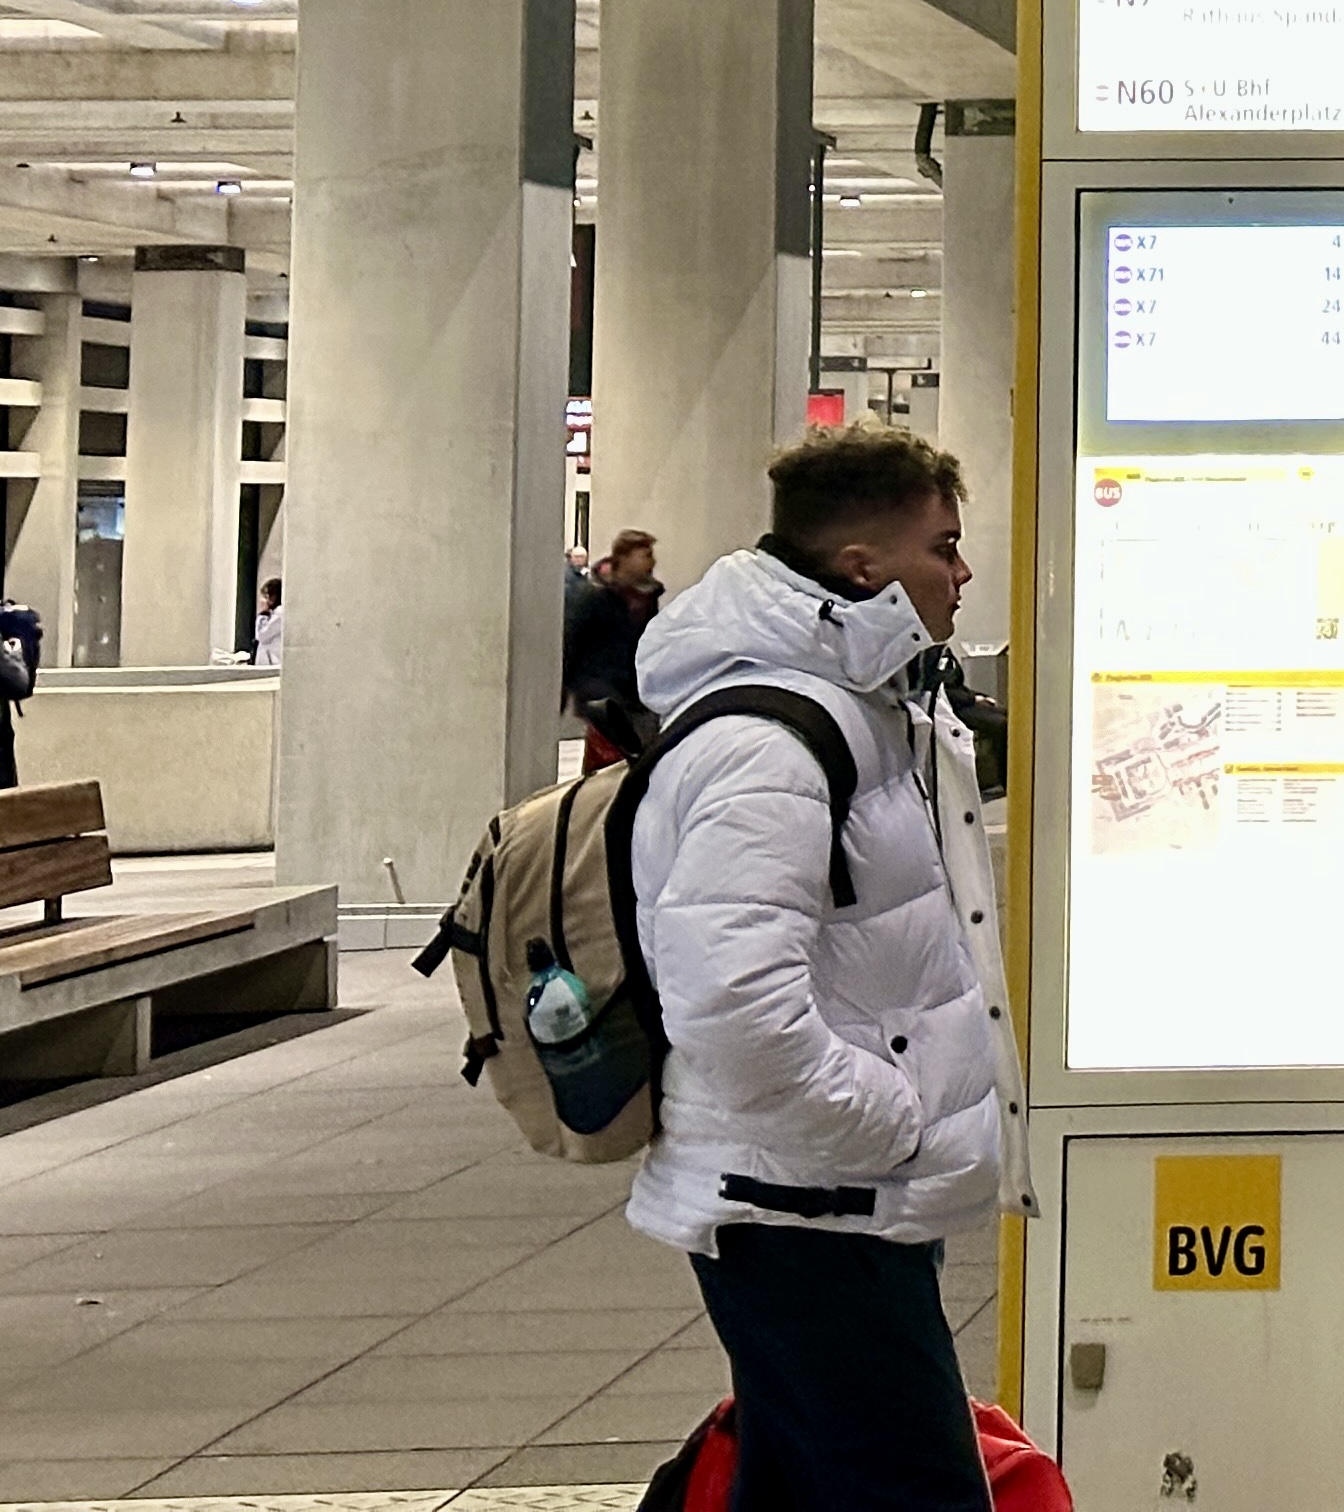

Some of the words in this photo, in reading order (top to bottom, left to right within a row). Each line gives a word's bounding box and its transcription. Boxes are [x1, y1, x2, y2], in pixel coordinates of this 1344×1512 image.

[1117, 79, 1175, 106] N60
[1184, 103, 1343, 125] Alexanderplatz
[1168, 1225, 1265, 1277] BVG
